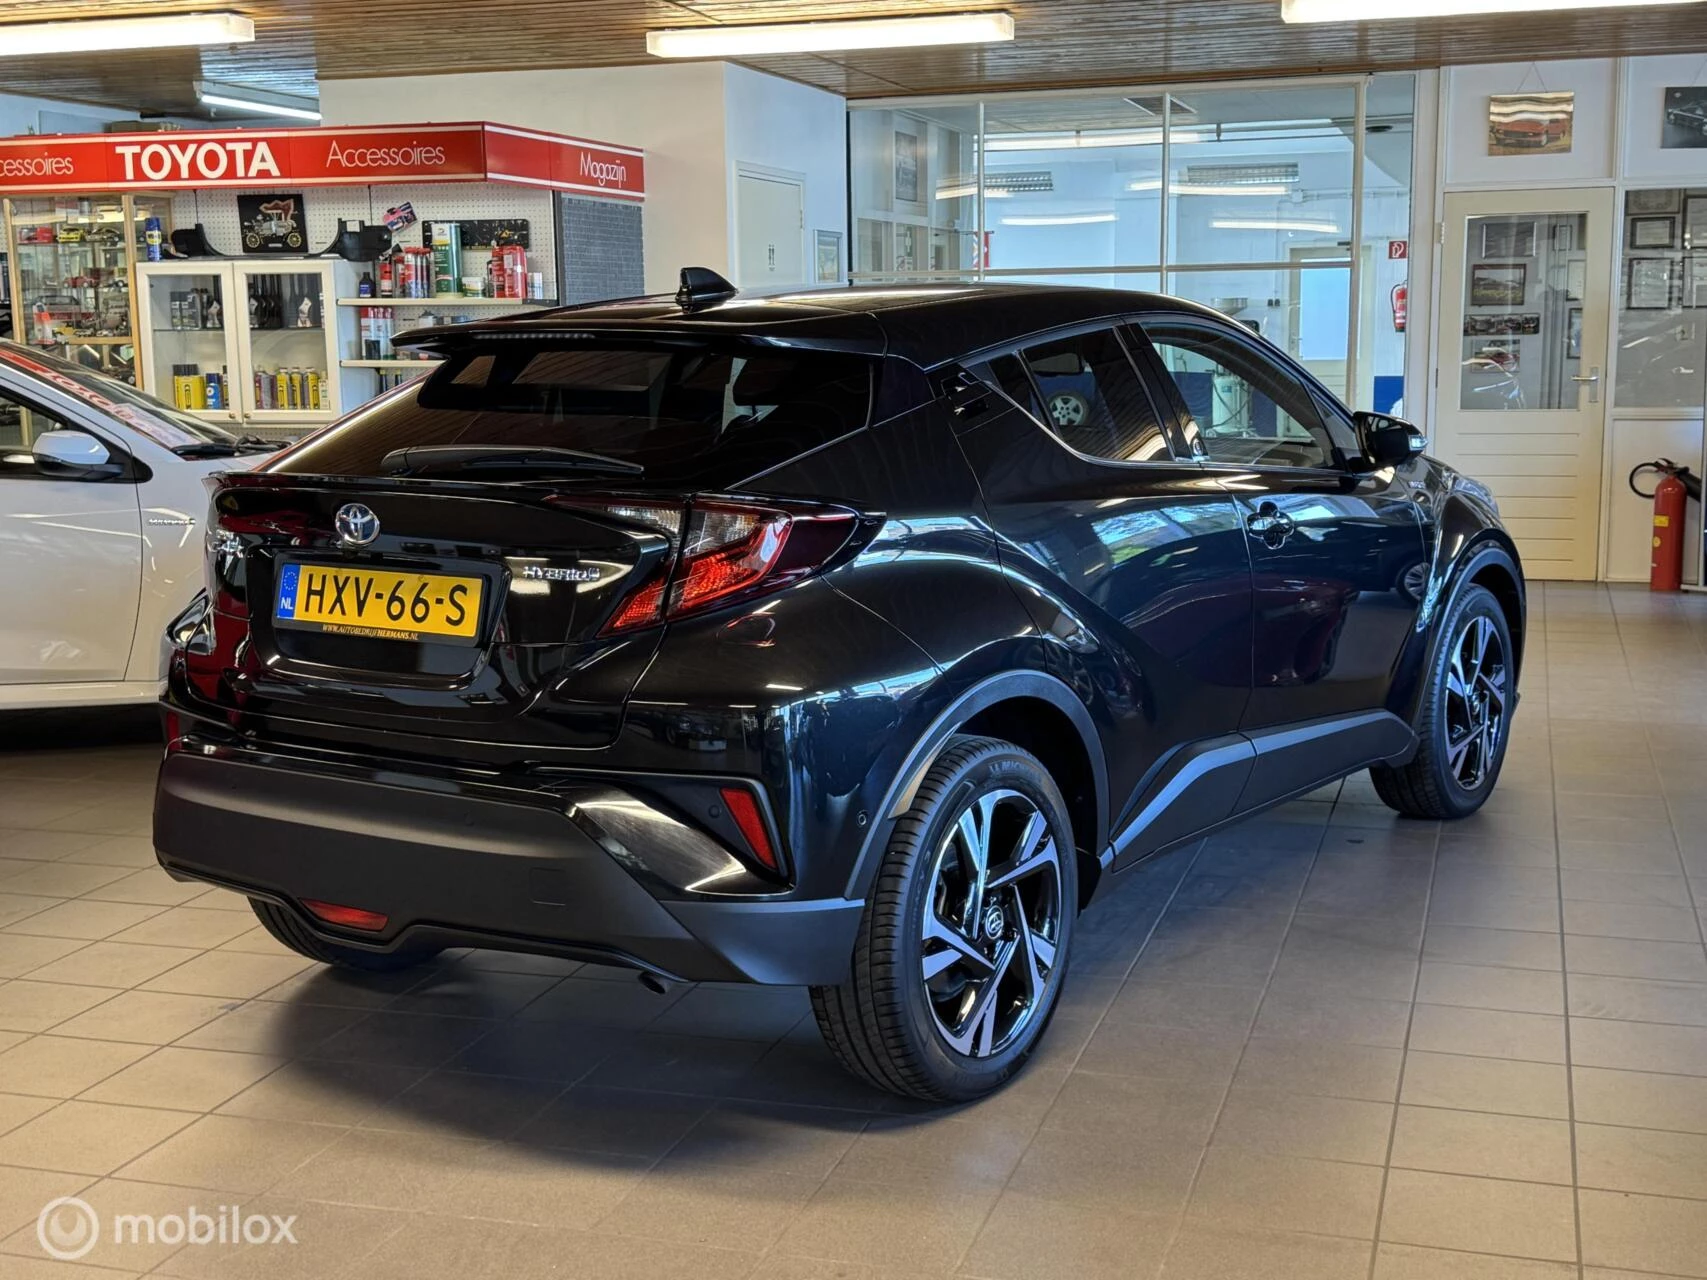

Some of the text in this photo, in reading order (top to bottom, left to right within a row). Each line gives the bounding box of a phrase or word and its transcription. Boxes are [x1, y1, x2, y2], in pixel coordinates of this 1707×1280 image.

[115, 141, 281, 181] TOYOTA
[326, 140, 446, 168] Accessoires
[580, 151, 627, 188] Magazijn
[280, 597, 294, 610] NL
[304, 573, 468, 627] HXV-66-S
